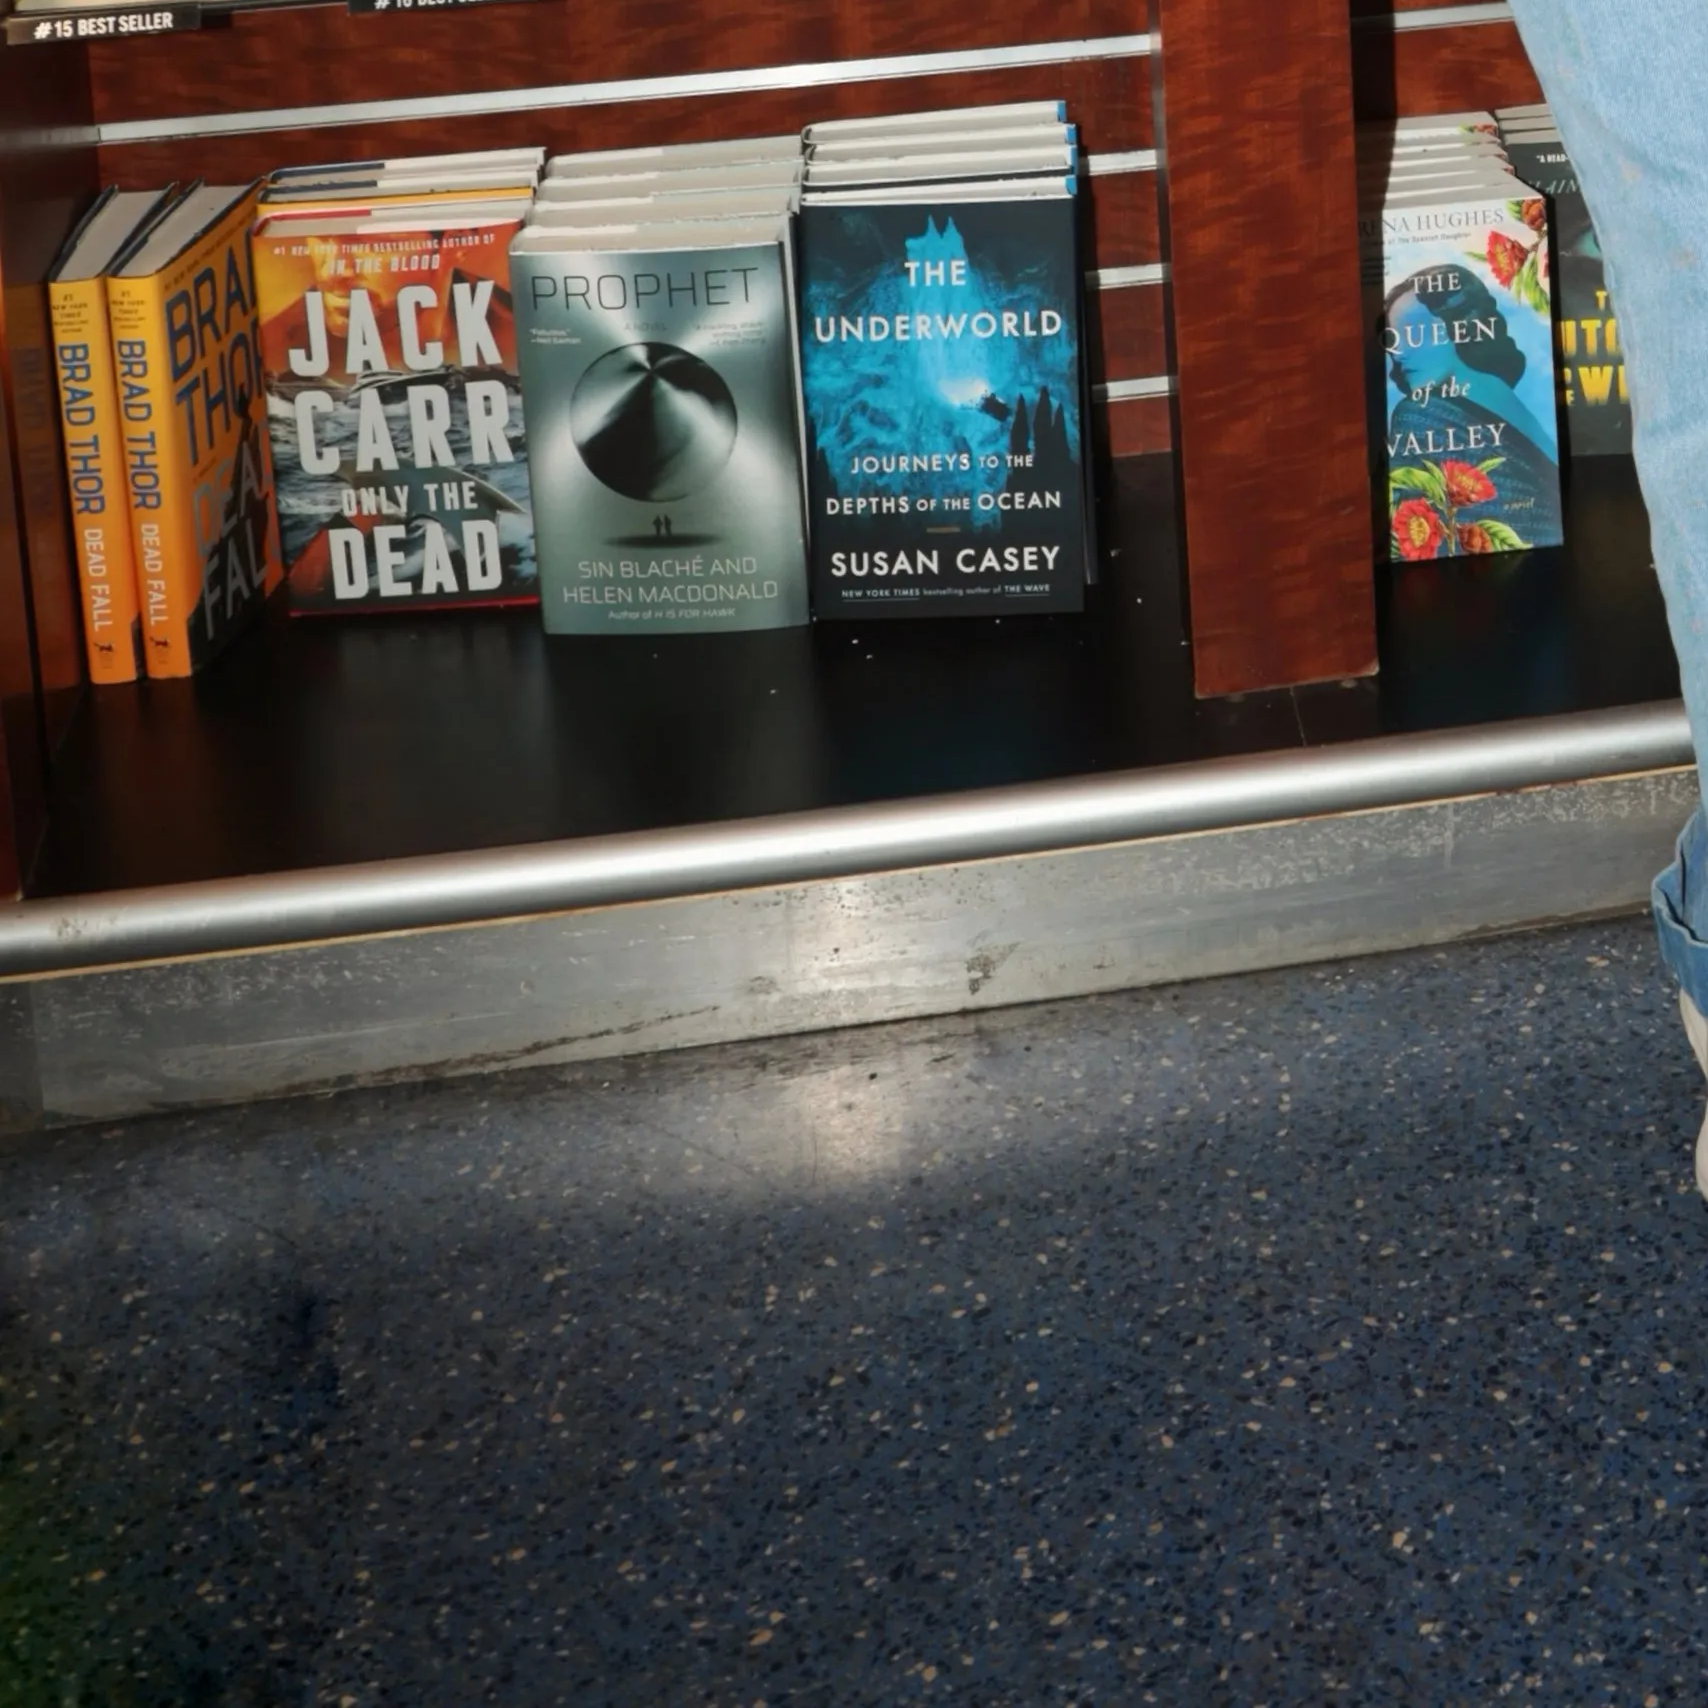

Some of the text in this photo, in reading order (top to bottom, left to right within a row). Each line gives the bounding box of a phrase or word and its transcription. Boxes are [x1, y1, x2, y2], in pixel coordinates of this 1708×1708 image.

[78, 16, 115, 35] BEST
[119, 12, 173, 32] SELLER
[289, 280, 502, 378] JACK
[815, 309, 1062, 343] UNDERWORLD
[1379, 316, 1497, 356] QUEEN
[58, 343, 105, 516] BRAD THOR
[293, 379, 513, 476] CARR
[1385, 423, 1506, 458] VALLEY
[825, 490, 1062, 516] DEPTHS OF THE OCEAN
[831, 545, 1060, 576] SUSAN CASEY
[563, 580, 778, 604] HELEN MACDONALD
